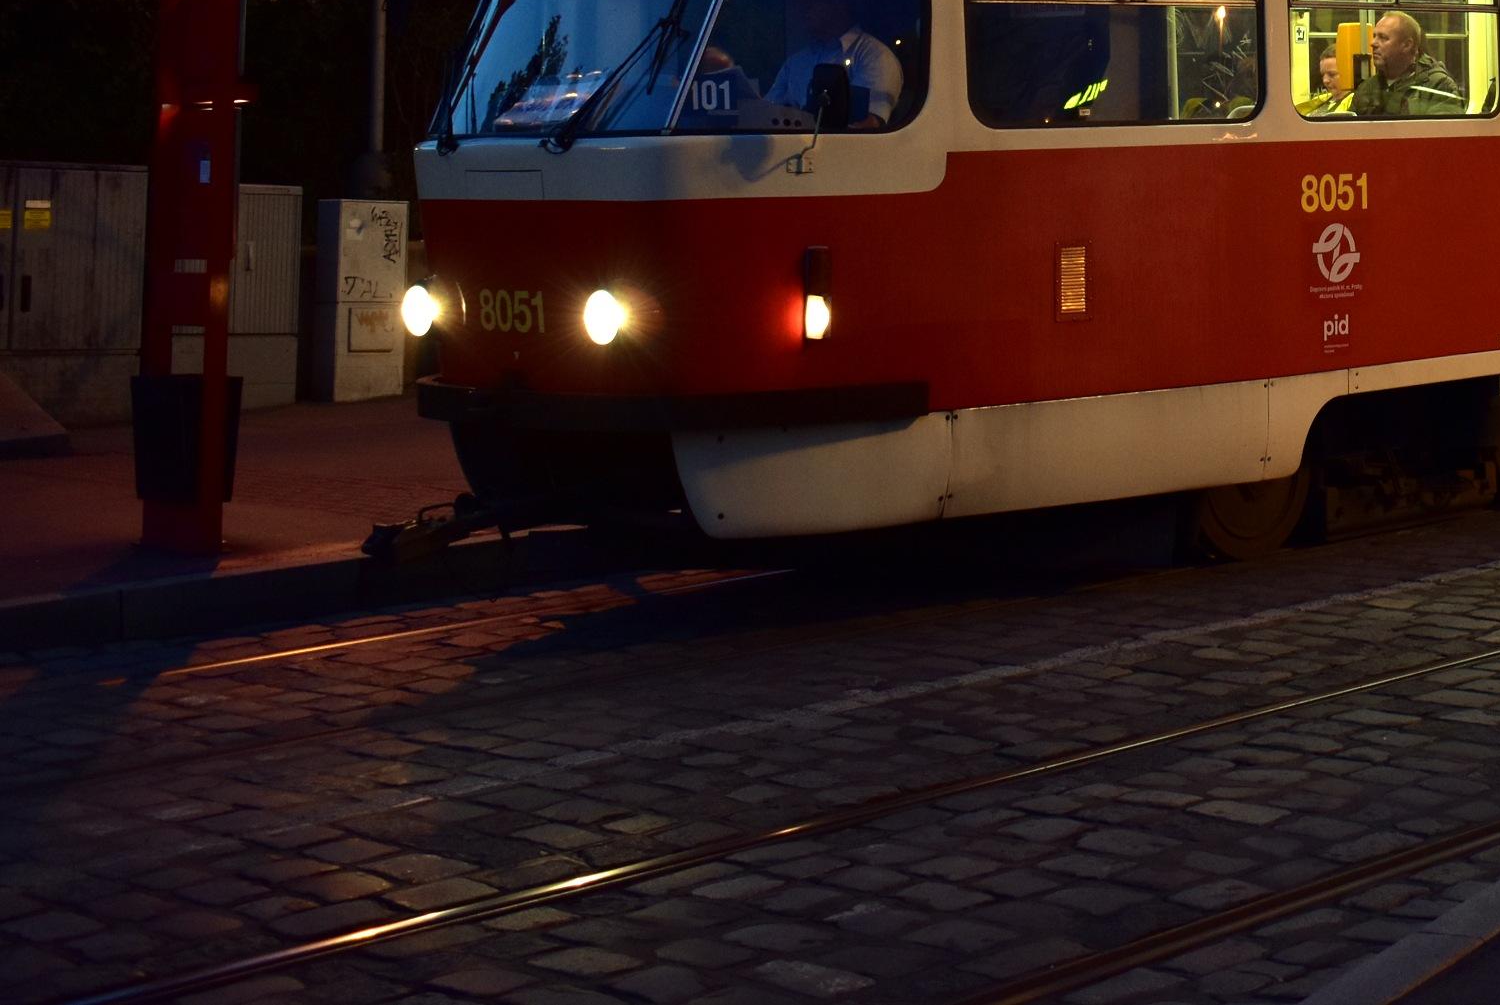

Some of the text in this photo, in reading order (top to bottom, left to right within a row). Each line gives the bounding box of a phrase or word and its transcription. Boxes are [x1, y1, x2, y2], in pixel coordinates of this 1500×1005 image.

[690, 80, 731, 111] 101
[1300, 172, 1368, 213] 8051
[479, 288, 545, 333] 8051
[1323, 313, 1349, 342] pid
